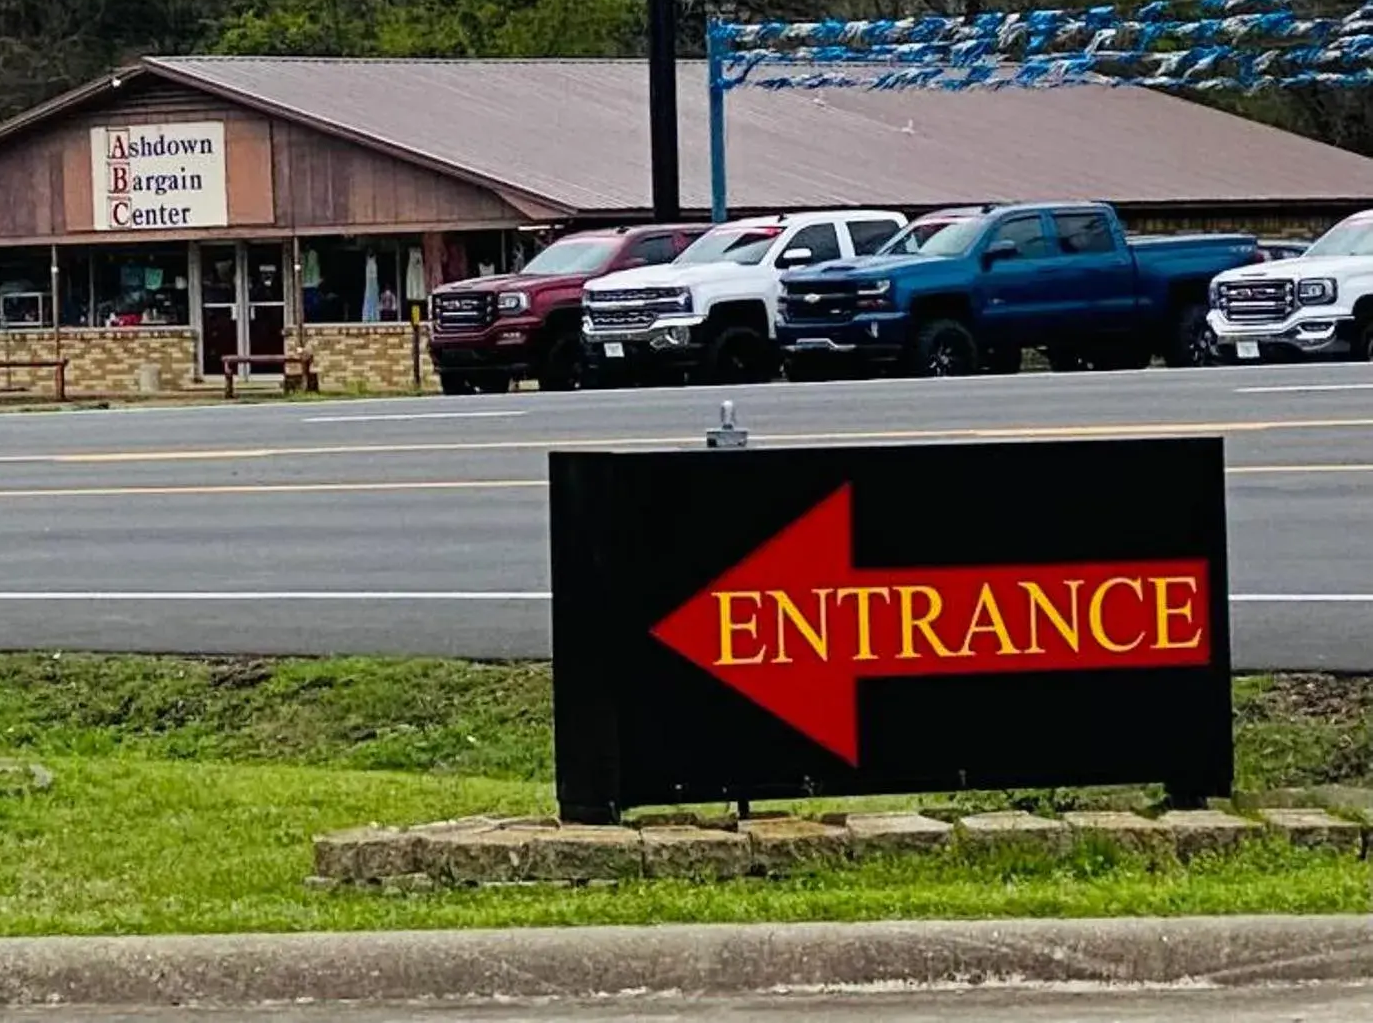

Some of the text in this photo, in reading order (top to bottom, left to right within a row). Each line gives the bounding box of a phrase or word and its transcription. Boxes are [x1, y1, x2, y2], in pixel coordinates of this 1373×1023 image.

[111, 134, 212, 158] Ashdown
[113, 166, 202, 195] Bargain
[113, 202, 191, 225] Center
[712, 575, 1204, 667] ENTRANCE
